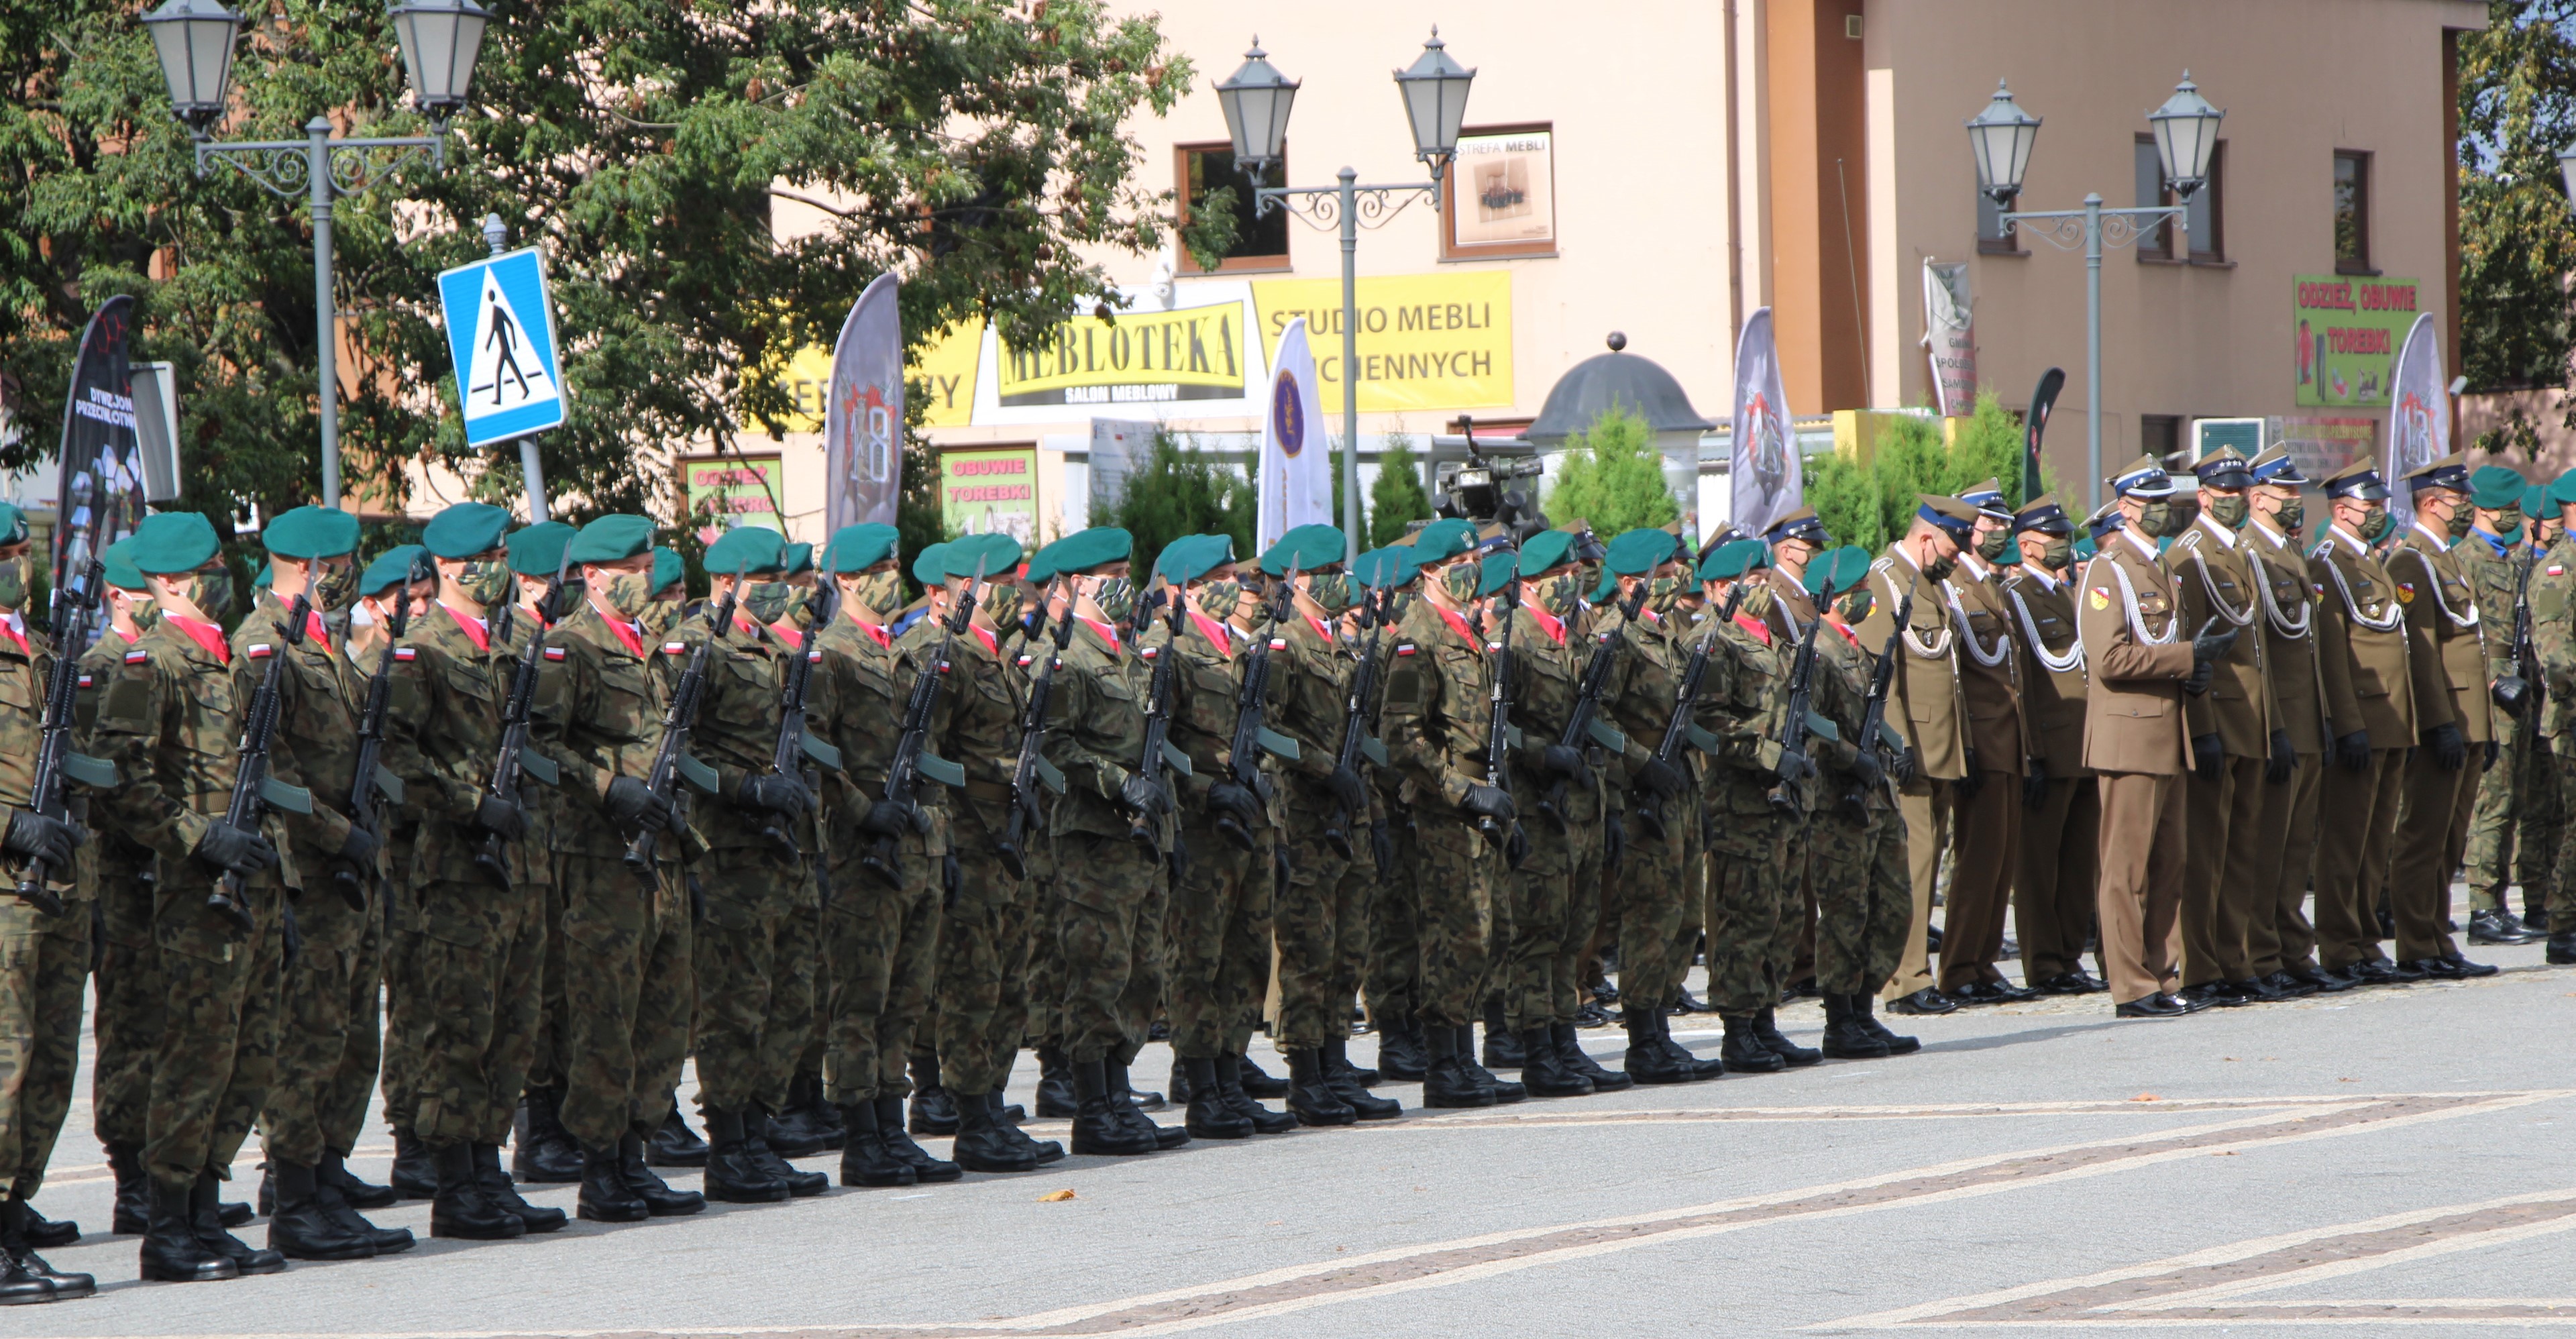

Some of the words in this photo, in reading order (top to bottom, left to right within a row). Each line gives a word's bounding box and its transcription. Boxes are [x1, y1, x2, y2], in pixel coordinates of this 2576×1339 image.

[1458, 142, 1501, 156] STREFA
[1505, 139, 1546, 152] MEBLI
[2360, 284, 2416, 311] OBUWIE
[1397, 302, 1491, 332] MEBLI
[1004, 312, 1238, 386] MEBLOTEKA
[2327, 326, 2391, 354] TOREBKI
[1311, 350, 1491, 382] CENNYCH
[1065, 386, 1109, 404] SALON
[1111, 384, 1178, 403] MEBLOWY
[951, 458, 1026, 476] OBUWIE
[947, 484, 1031, 502] TOREBKI
